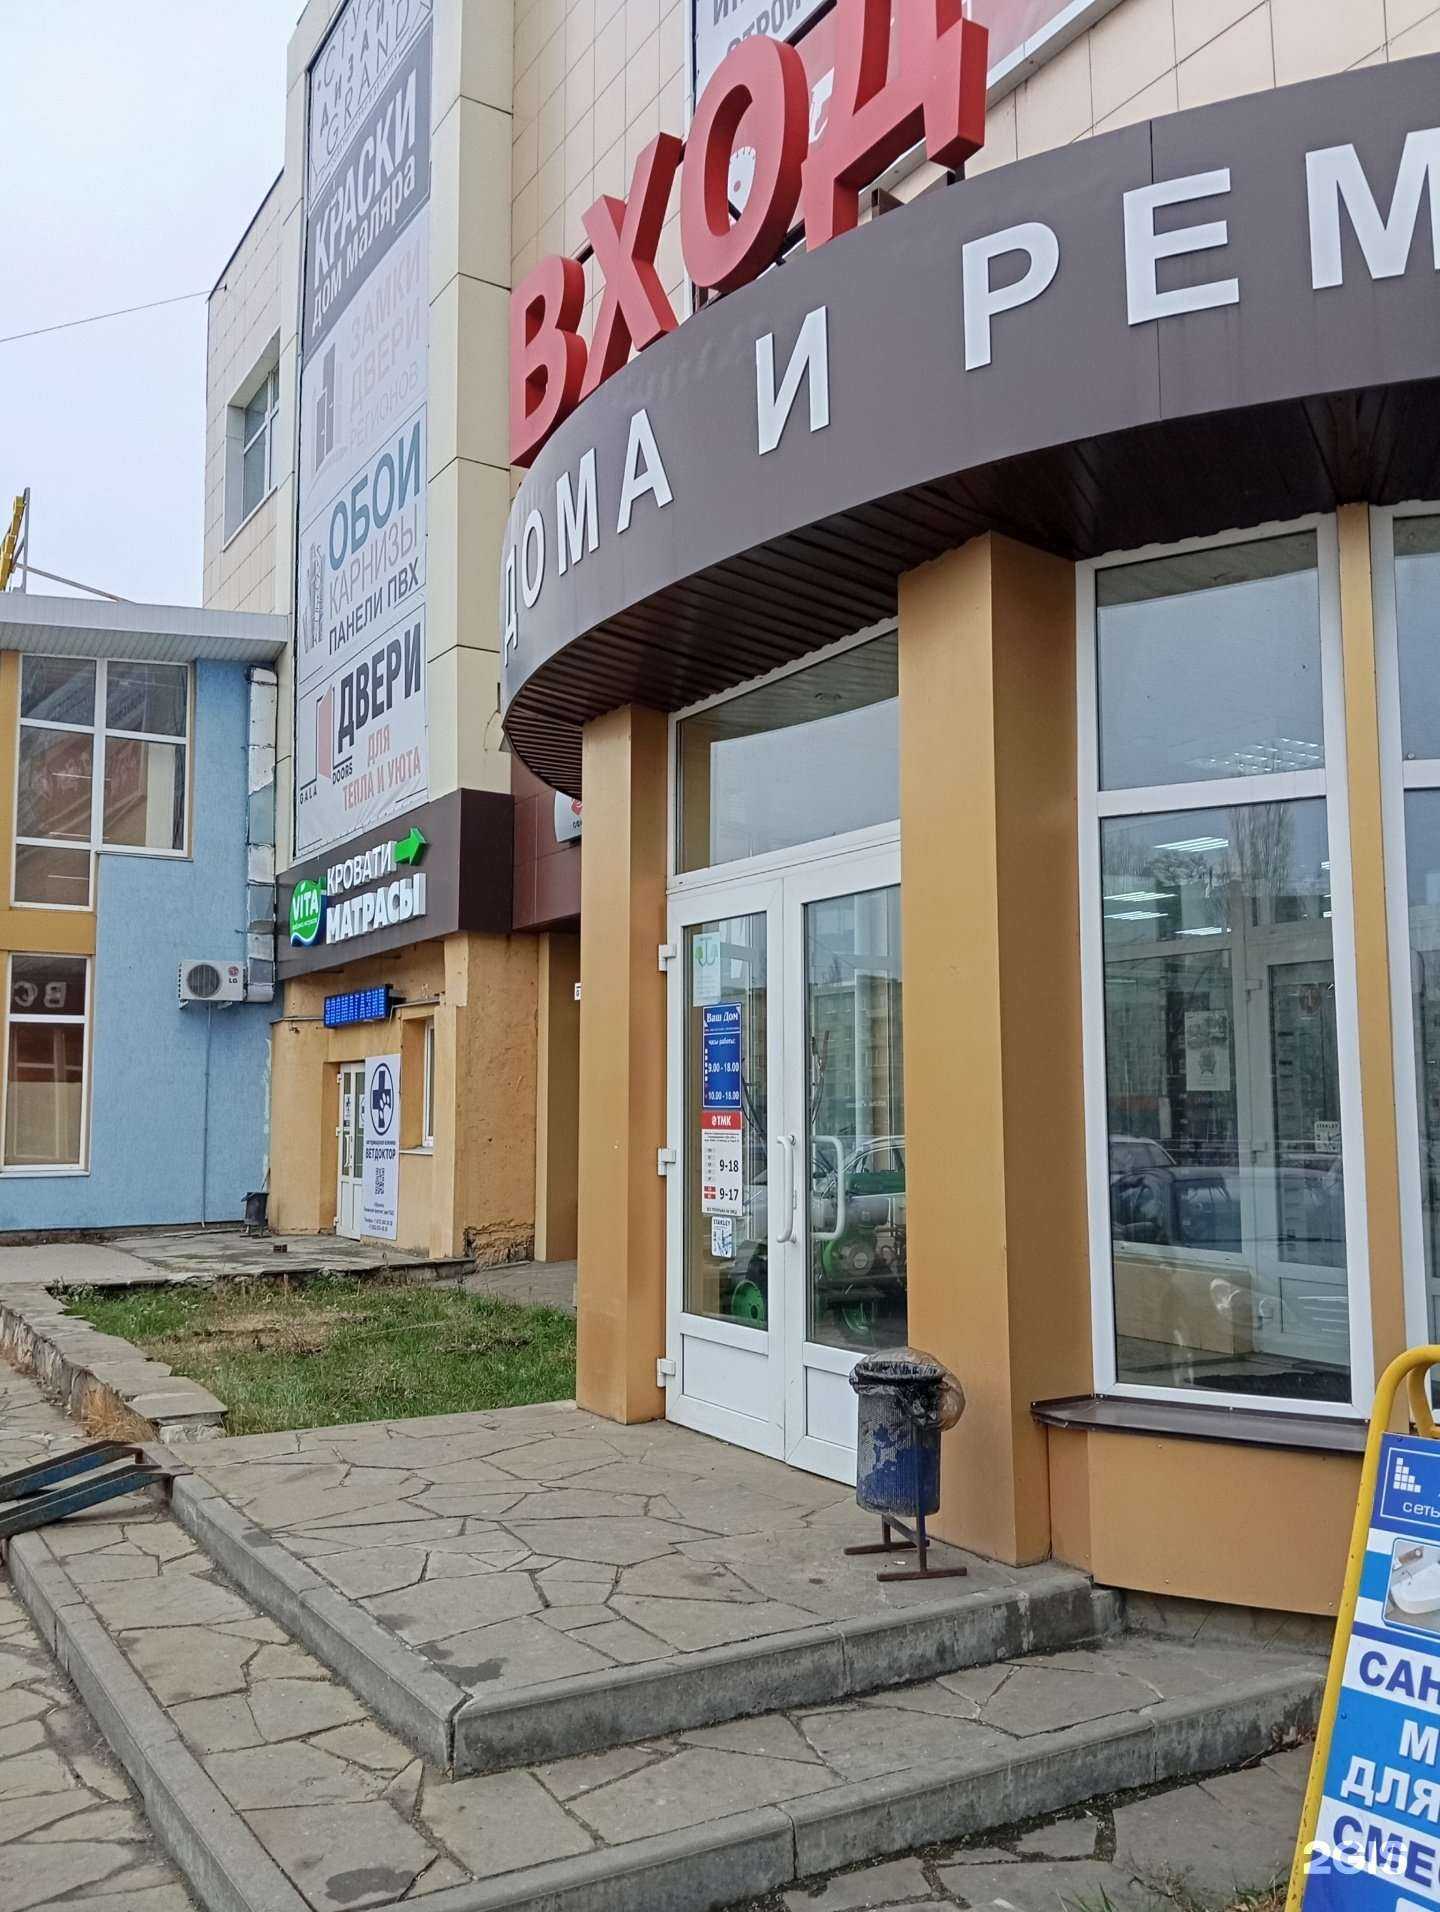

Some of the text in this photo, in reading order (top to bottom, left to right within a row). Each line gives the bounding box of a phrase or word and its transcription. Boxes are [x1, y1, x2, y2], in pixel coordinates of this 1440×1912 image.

[314, 67, 417, 289] КРАСКИ
[510, 0, 989, 467] ВХОД
[351, 238, 420, 360] ЗАМКИ
[351, 297, 420, 413] ДВЕРИ
[504, 408, 674, 668] ДОМА
[756, 305, 831, 456] И
[962, 127, 1440, 371] РЕМ
[329, 420, 420, 571] ОБОИ
[329, 503, 417, 619] КАРНИЗЫ
[329, 587, 383, 655] ПАНЕЛИ
[387, 557, 420, 608] ПВХ
[337, 621, 421, 754] ДВЕРИ
[332, 763, 353, 785] DOORS
[343, 771, 375, 811] ТЕПЛА
[377, 764, 385, 793] И
[387, 746, 421, 788] УЮТА
[367, 723, 391, 767] ДЛЯ
[299, 785, 318, 805] GALA
[327, 840, 398, 896] КРОВАТИ
[326, 873, 427, 944] МАТРАСЫ
[706, 1011, 739, 1023] Ваш Дом
[365, 1147, 396, 1160] ВЕТДОКТОР
[719, 1159, 739, 1173] 9-18
[719, 1187, 739, 1201] 9-17
[1402, 1501, 1440, 1518] сеть
[1359, 1650, 1440, 1706] САН
[1340, 1754, 1440, 1824] ДЛЯ
[1333, 1815, 1440, 1889] СМЕ
